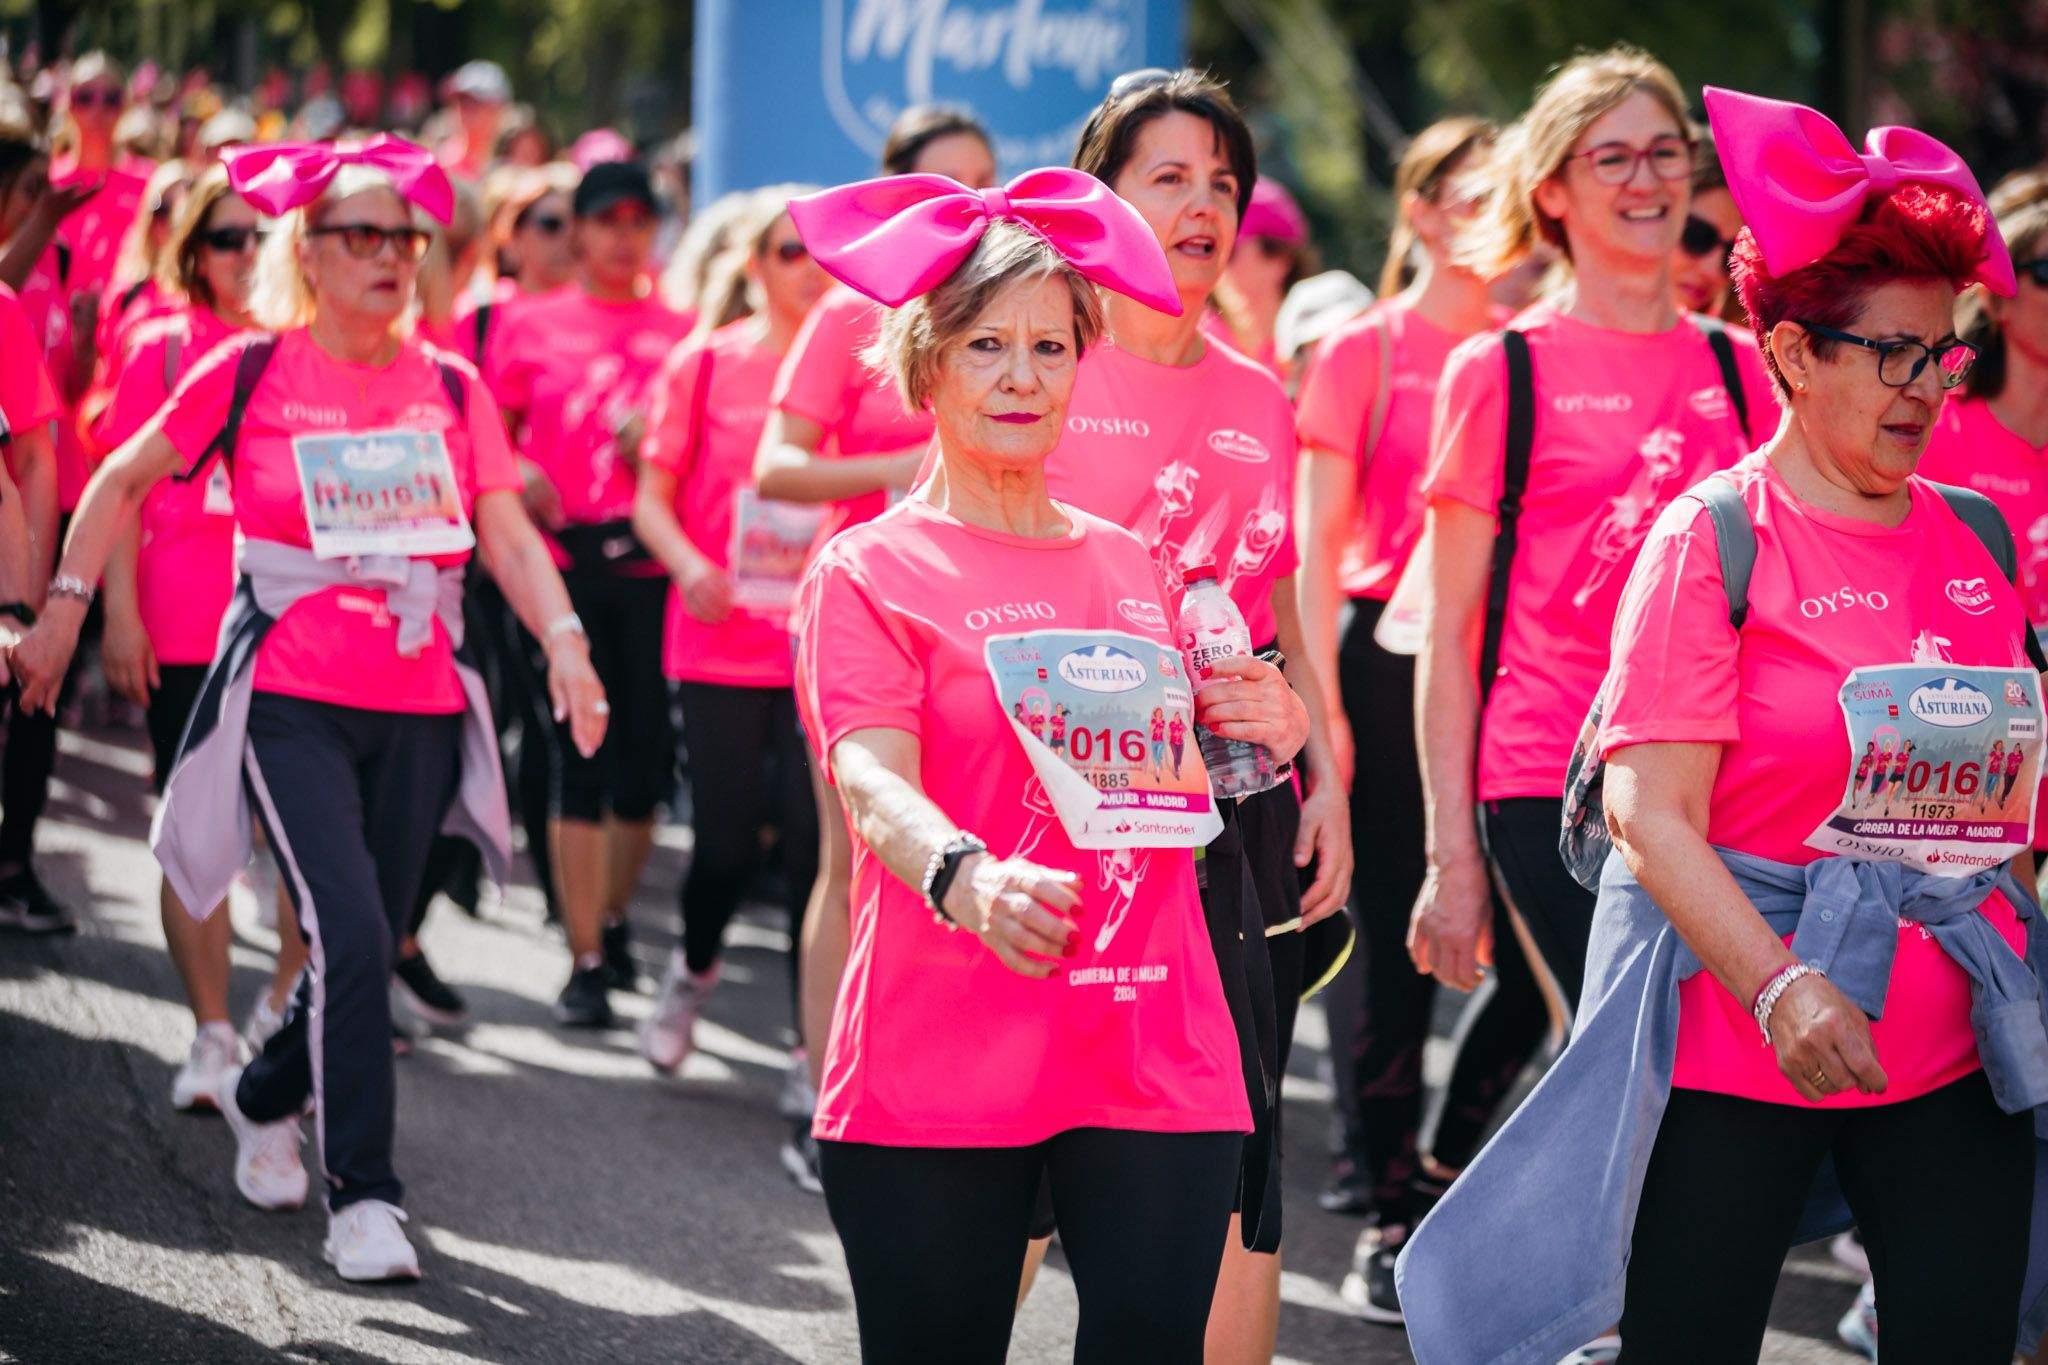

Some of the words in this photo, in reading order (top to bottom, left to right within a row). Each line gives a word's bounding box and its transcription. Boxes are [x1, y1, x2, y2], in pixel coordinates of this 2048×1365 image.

[1067, 416, 1150, 438] OYSHO
[965, 600, 1057, 630] OYSHO
[1191, 644, 1233, 661] ZERO
[1064, 661, 1142, 683] ASTURIANA
[1853, 687, 1894, 702] SUMA
[1915, 694, 1988, 715] ASTURIANA
[1070, 726, 1146, 763] 016
[1083, 772, 1130, 789] 11885
[1907, 760, 1981, 796] 016
[1101, 791, 1140, 806] MUJER
[1146, 793, 1188, 809] MADRID
[1910, 803, 1955, 820] 11973
[1134, 820, 1196, 835] Santander
[1853, 821, 1895, 835] CARRERA
[1897, 822, 1911, 835] DE
[1912, 823, 1925, 836] LA
[1926, 824, 1959, 836] MUJER
[1965, 826, 2004, 838] MADRID
[1836, 838, 1905, 858] OYSHO
[1941, 851, 2002, 867] Santander
[1117, 966, 1131, 983] DE
